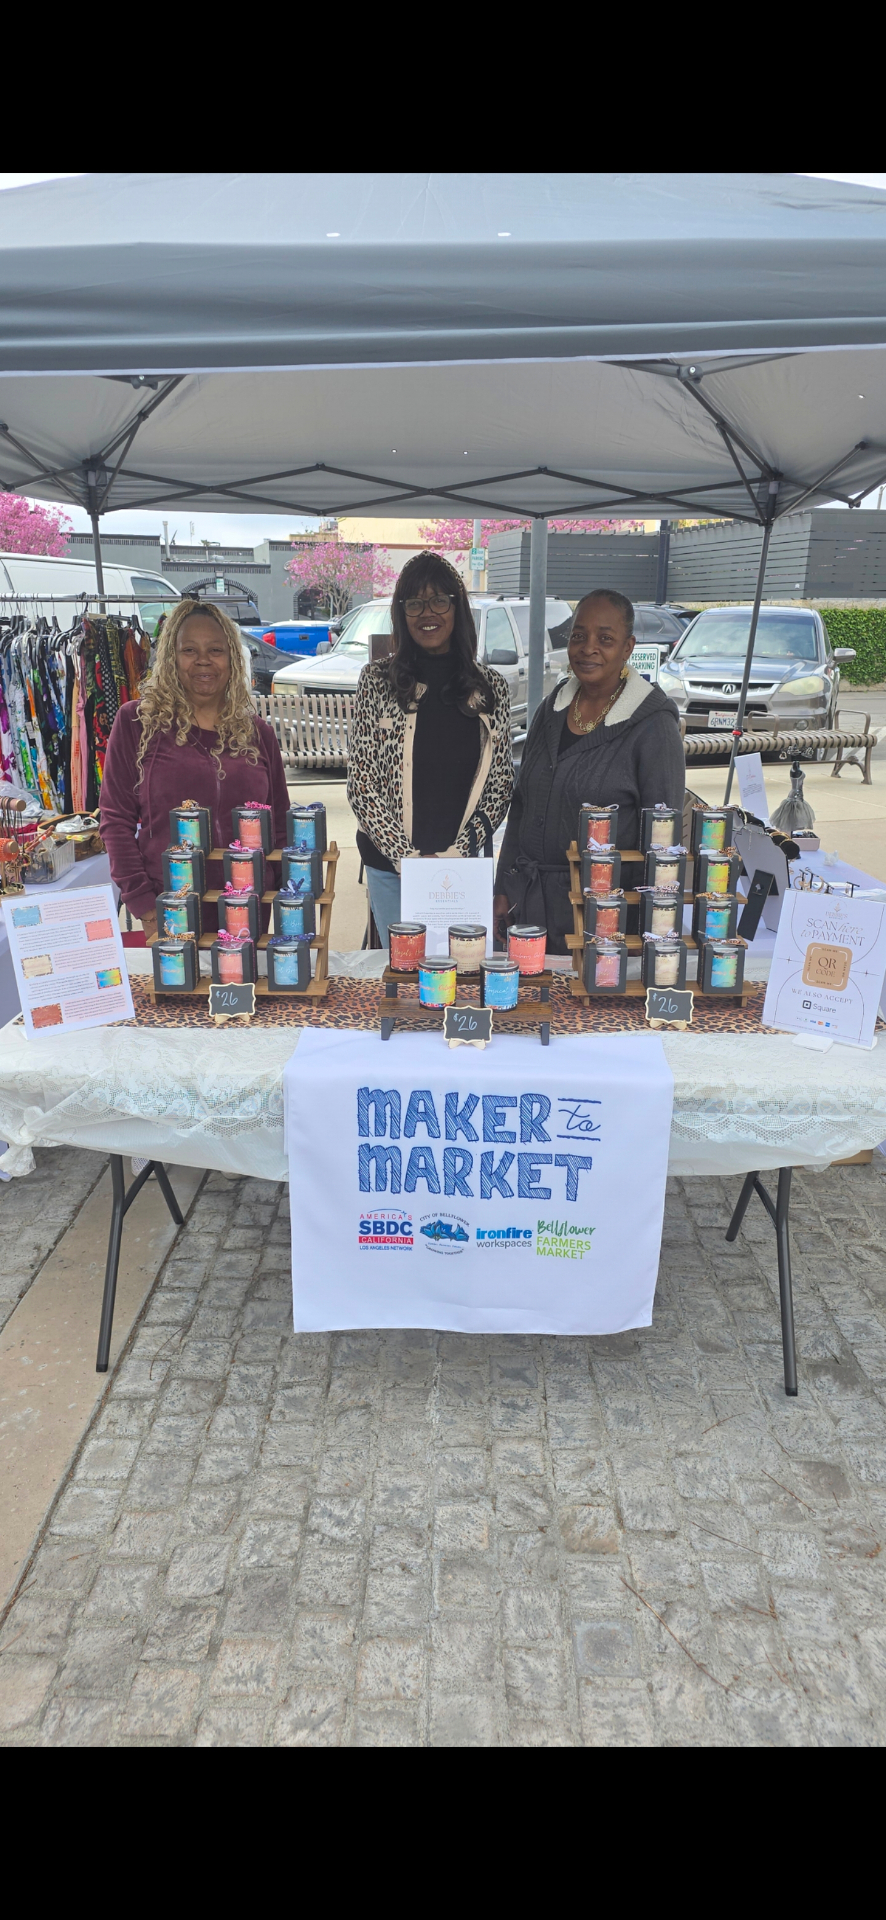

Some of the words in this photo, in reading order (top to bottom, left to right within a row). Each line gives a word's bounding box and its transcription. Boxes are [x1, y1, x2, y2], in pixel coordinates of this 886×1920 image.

[631, 652, 656, 661] RESERVED
[632, 661, 655, 670] PARKING
[710, 717, 738, 727] 6RNM32
[428, 892, 466, 900] DEBBIE'S
[806, 918, 838, 931] SCAN
[837, 922, 864, 935] here
[800, 929, 811, 938] to
[811, 930, 866, 947] PAYMENT
[817, 957, 837, 969] QR
[815, 968, 836, 978] CODE
[216, 990, 239, 1007] $26
[652, 992, 679, 1014] $26
[803, 990, 823, 999] ALSO
[824, 994, 854, 1005] ACCEPT
[813, 1003, 837, 1014] Square
[453, 1012, 478, 1032] $26
[357, 1087, 552, 1144] MAKER
[558, 1104, 602, 1132] to
[358, 1143, 593, 1202] MARKET
[420, 1214, 431, 1222] CITY
[439, 1212, 470, 1227] BELLFLOWER
[359, 1220, 413, 1236] SBDC
[476, 1227, 533, 1239] ironfire
[537, 1219, 597, 1237] Bellflower
[361, 1236, 412, 1245] CALIFORNIA
[476, 1239, 533, 1250] workspaces
[536, 1236, 592, 1251] FARMERS
[536, 1246, 586, 1260] MARKET
